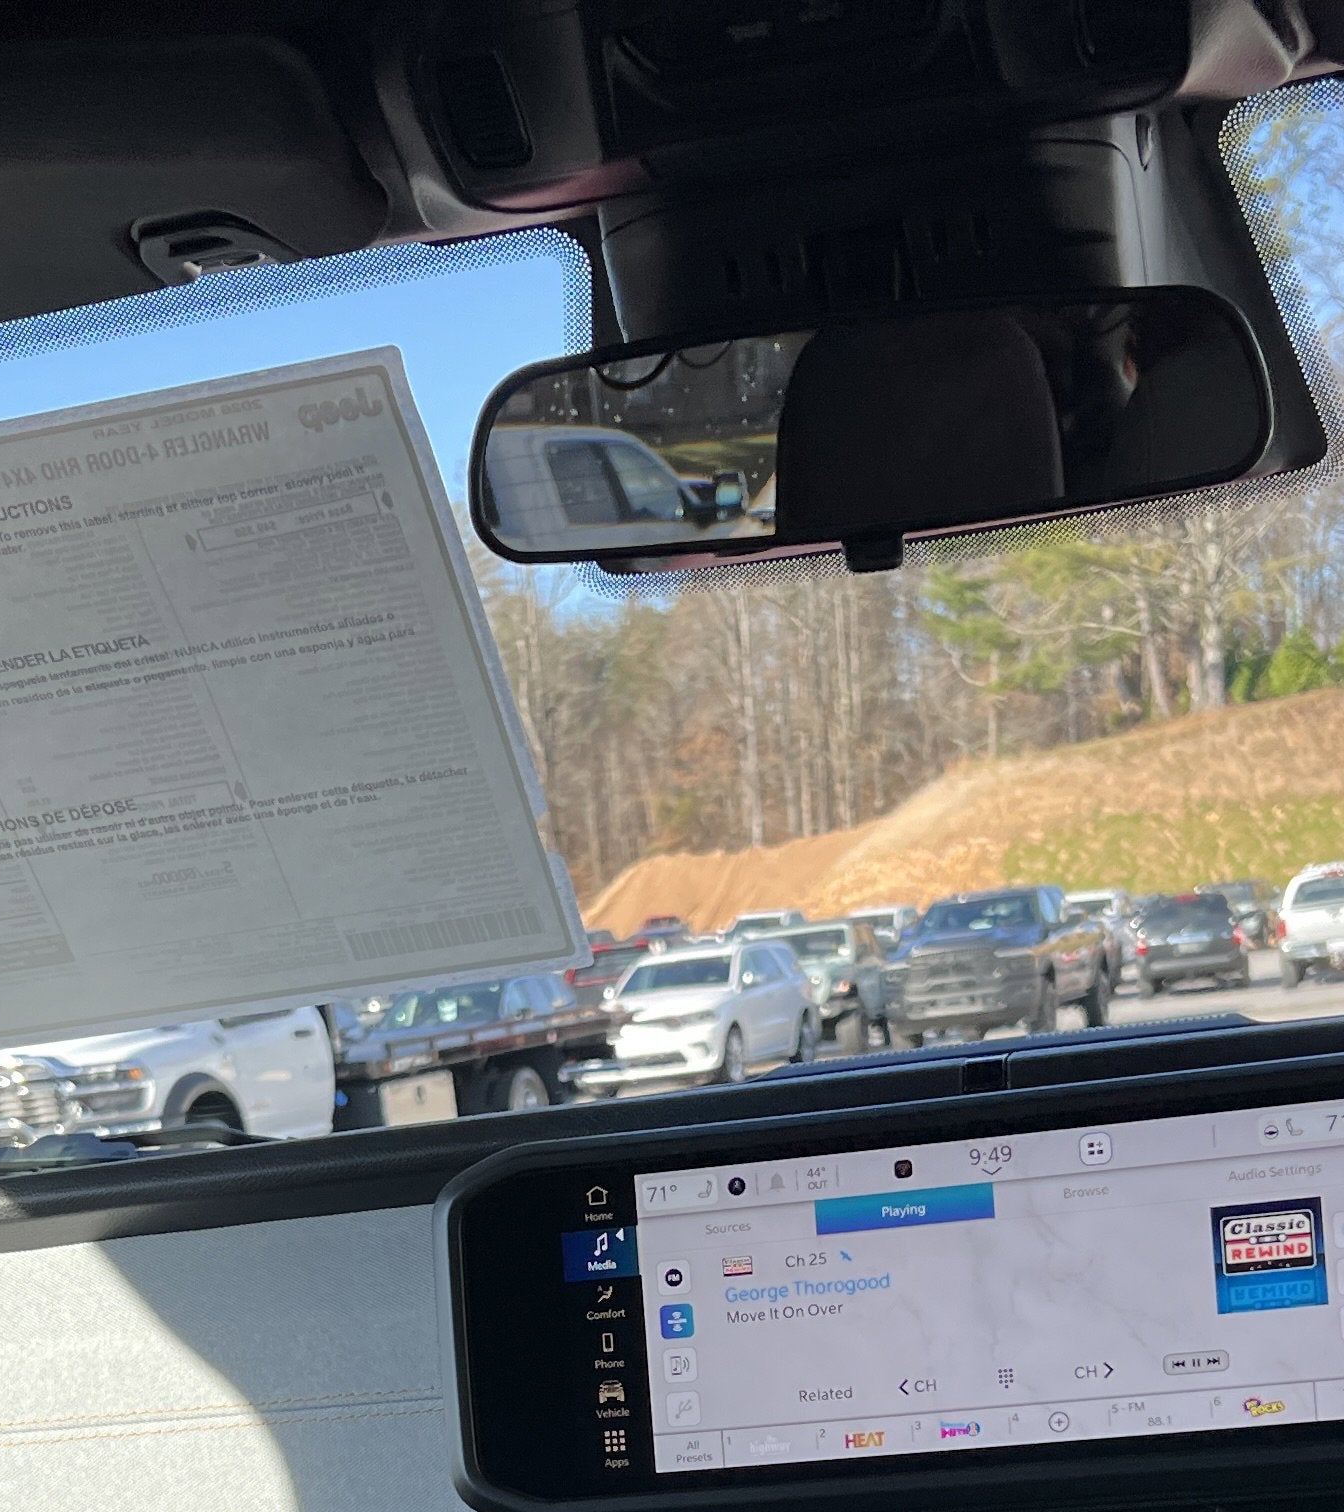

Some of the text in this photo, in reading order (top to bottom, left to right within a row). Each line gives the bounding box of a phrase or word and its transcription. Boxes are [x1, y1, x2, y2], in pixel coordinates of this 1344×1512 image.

[14, 526, 56, 540] remove
[58, 519, 80, 532] this
[50, 647, 73, 664] LA
[71, 634, 151, 660] ETIQUETA
[250, 652, 270, 663] con
[274, 648, 296, 659] una
[44, 810, 67, 826] DE
[69, 797, 139, 822] DÉPOSE
[968, 1145, 1013, 1167] 9:49
[806, 1166, 826, 1179] 44°
[1227, 1161, 1323, 1183] Audio Settings
[807, 1179, 828, 1191] OUT
[1063, 1184, 1110, 1200] Browse
[646, 1183, 678, 1203] 71°
[585, 1212, 613, 1222] Home
[881, 1203, 926, 1219] Playing
[705, 1221, 752, 1235] Sources
[1230, 1219, 1305, 1235] Classic
[1231, 1242, 1309, 1260] REWIND
[587, 1260, 618, 1272] Media
[785, 1253, 828, 1268] Ch 25
[725, 1273, 891, 1304] George Thorogood
[586, 1308, 626, 1320] Comfort
[726, 1303, 844, 1324] Move It On Over
[594, 1358, 625, 1369] Phone
[1074, 1365, 1098, 1380] CH
[914, 1379, 937, 1394] CH
[799, 1386, 854, 1403] Related
[596, 1406, 630, 1419] Vehicle
[1128, 1401, 1145, 1412] FM
[1147, 1415, 1172, 1427] 88.1
[686, 1440, 700, 1451] All
[845, 1431, 886, 1449] HEAT
[605, 1457, 630, 1469] Apps
[676, 1453, 713, 1464] Presets
